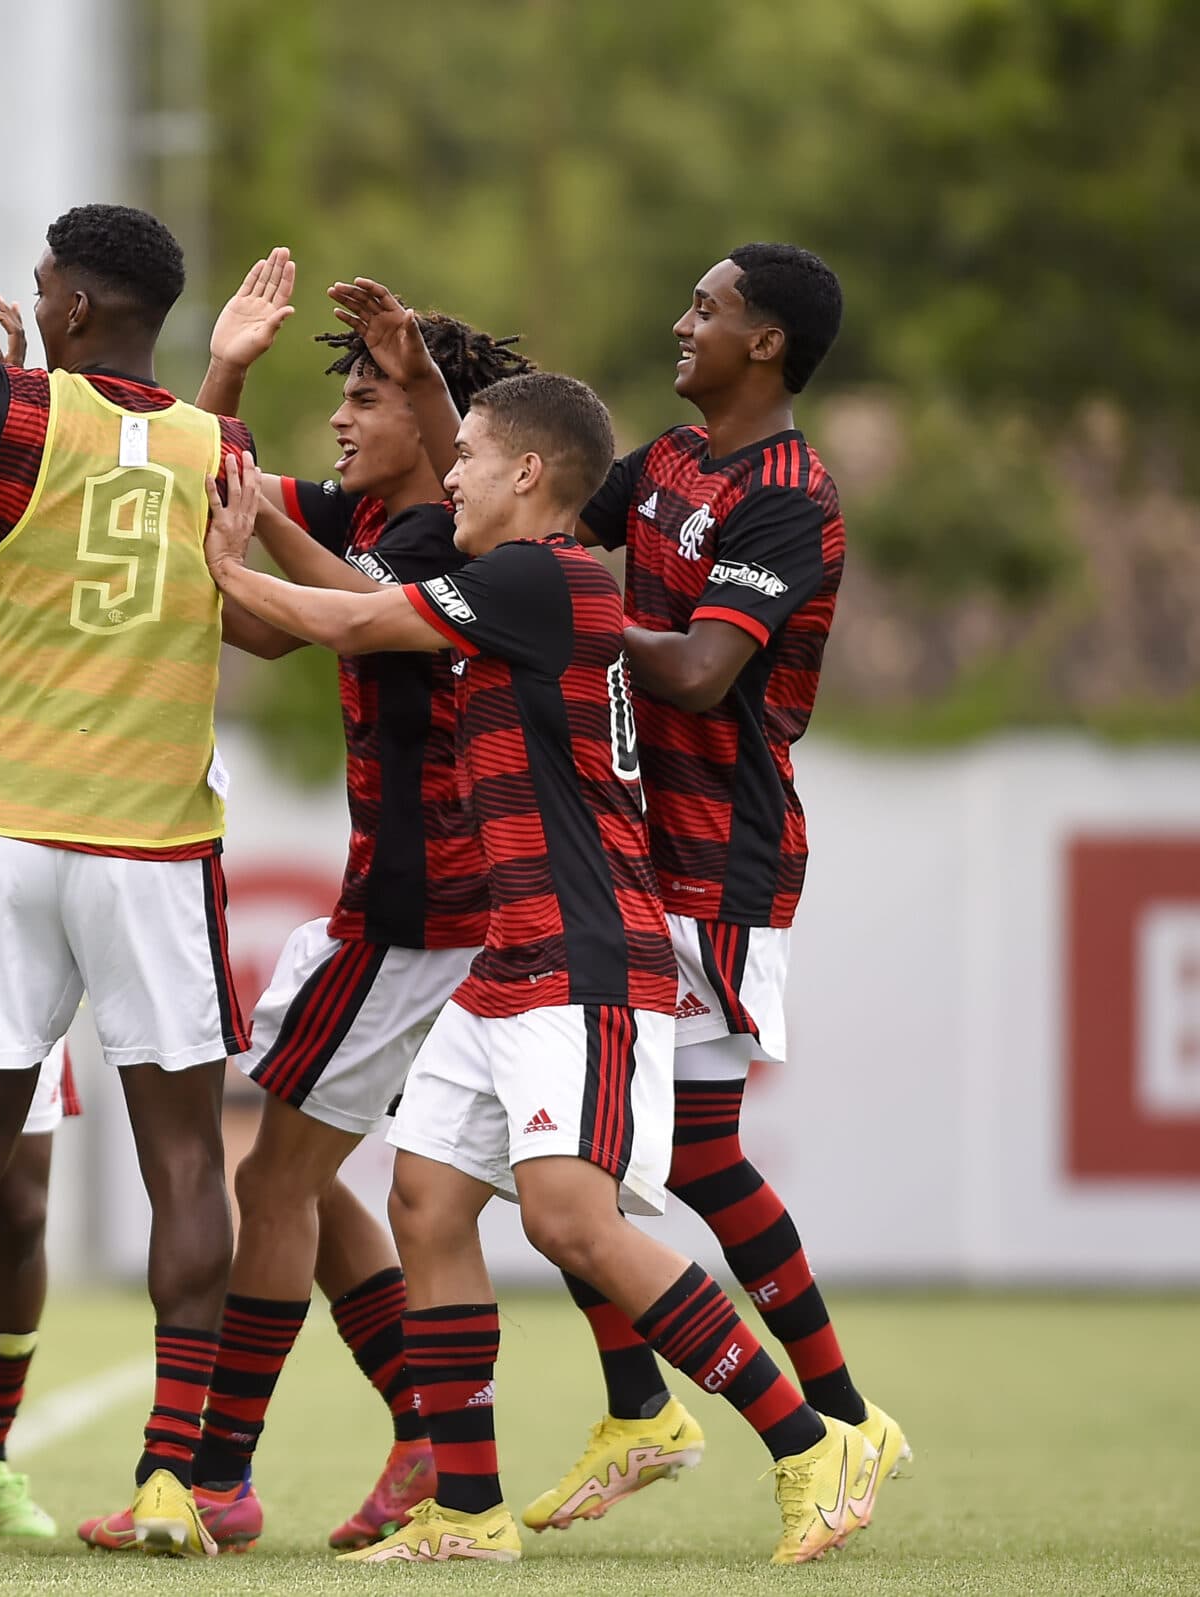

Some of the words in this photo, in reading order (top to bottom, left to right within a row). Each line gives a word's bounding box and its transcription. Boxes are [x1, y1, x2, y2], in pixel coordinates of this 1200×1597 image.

[145, 490, 161, 517] TIM
[70, 462, 175, 636] 9
[523, 1122, 558, 1135] adidas
[704, 1342, 744, 1390] CRF
